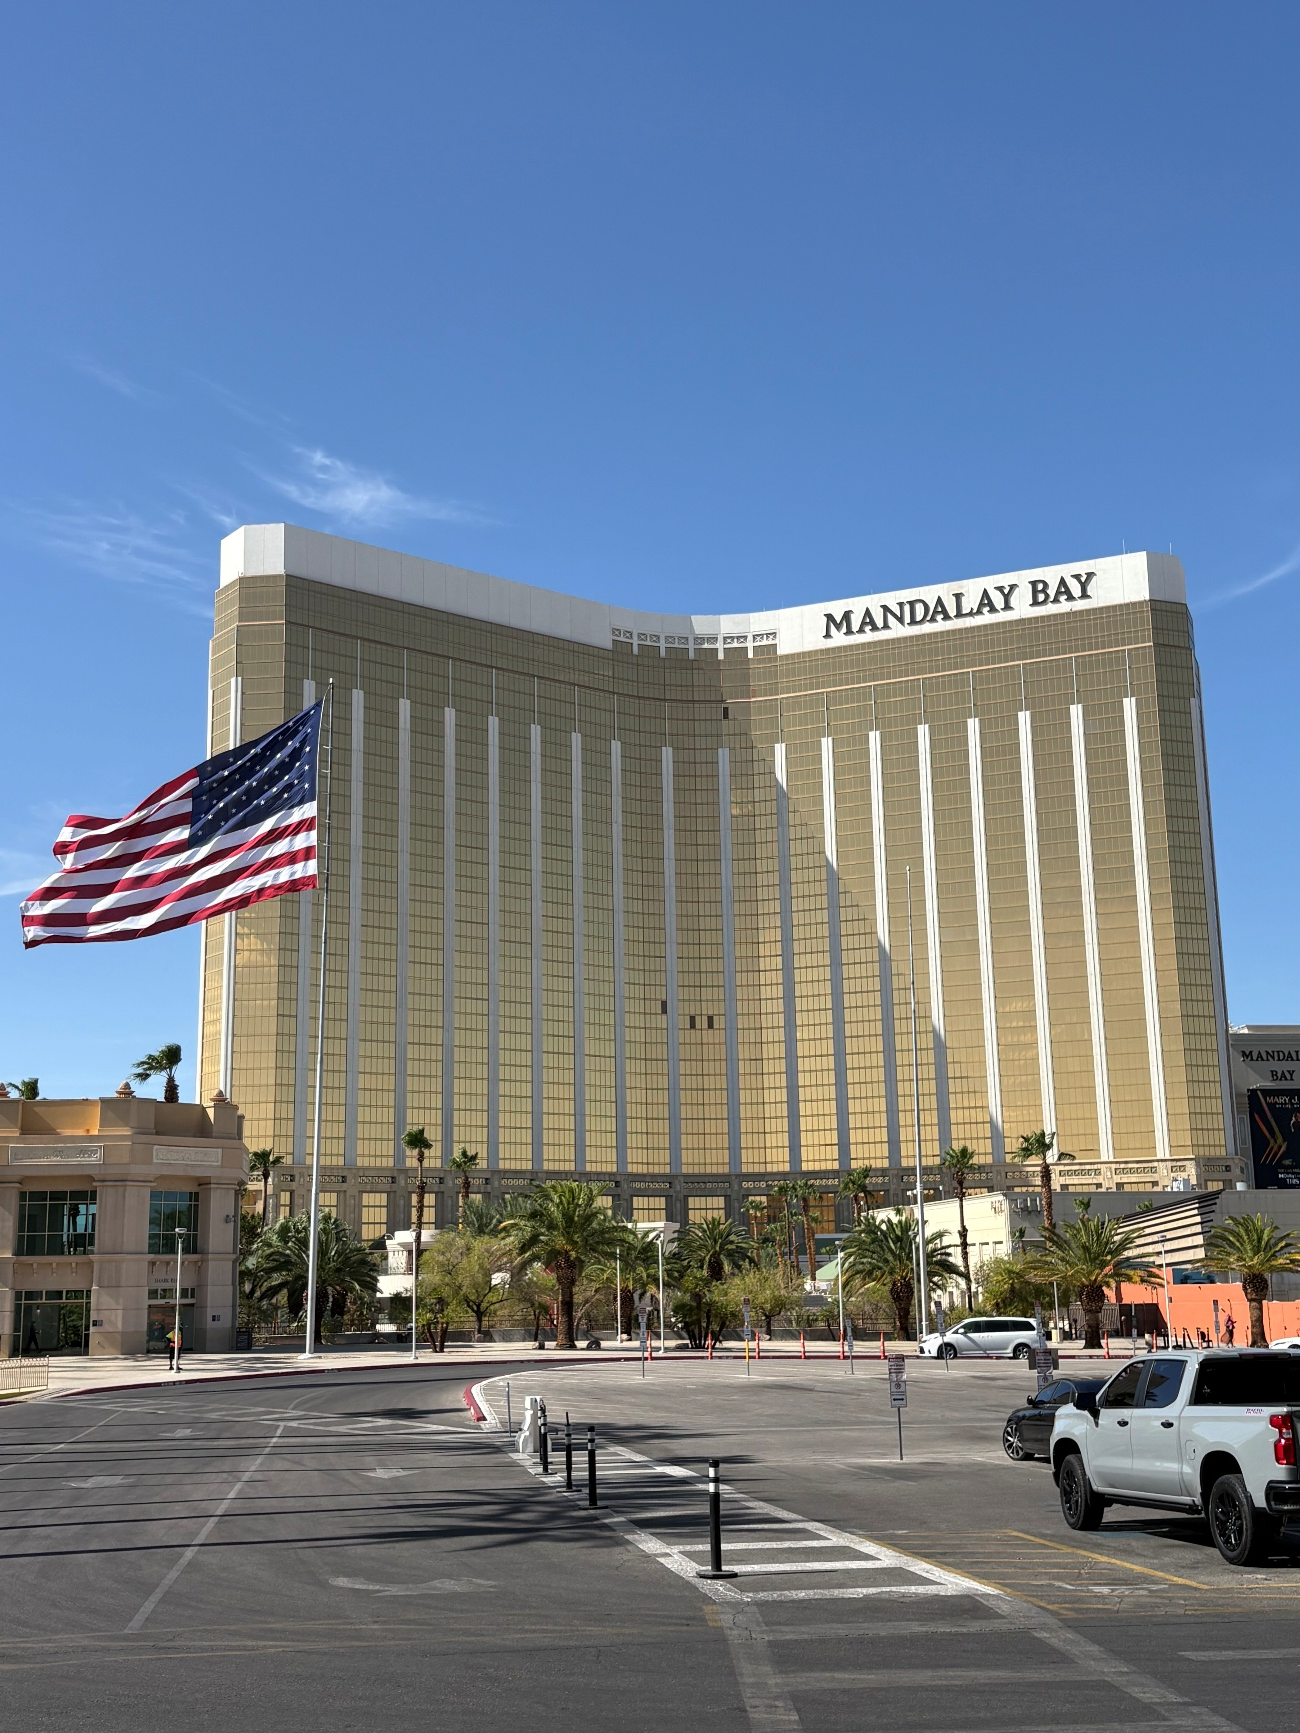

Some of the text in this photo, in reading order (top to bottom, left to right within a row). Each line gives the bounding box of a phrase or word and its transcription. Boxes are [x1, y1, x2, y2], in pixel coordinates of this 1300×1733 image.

[822, 571, 1097, 639] MANDALAY BAY
[1270, 1069, 1295, 1081] BAY
[1266, 1096, 1290, 1104] MARY
